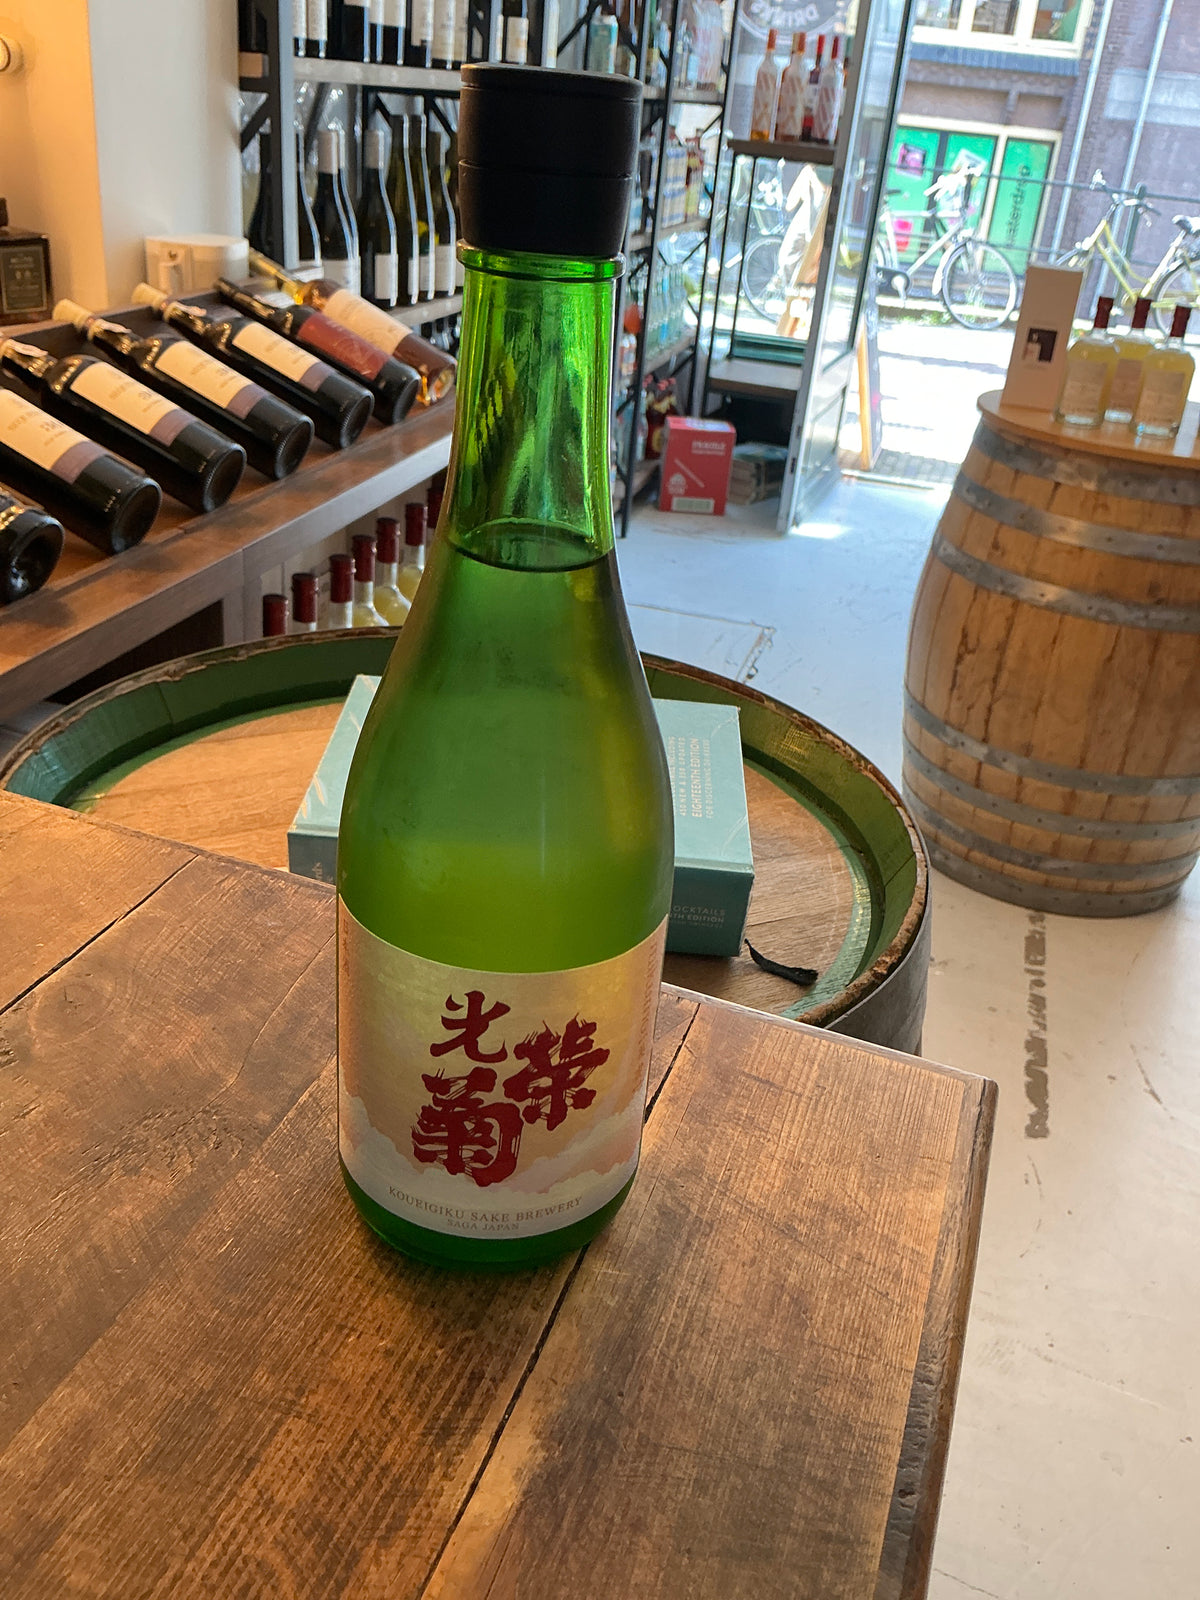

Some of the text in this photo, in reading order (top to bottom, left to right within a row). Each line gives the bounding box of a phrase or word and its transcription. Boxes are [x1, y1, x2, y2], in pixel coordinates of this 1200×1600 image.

[690, 738, 703, 818] EIGHTEENTH EDITION
[673, 905, 726, 916] OCKTAILS
[389, 1186, 582, 1222] KOUEIGIKU SAKE BREWERY
[447, 1219, 519, 1231] SAGA JAPAN
